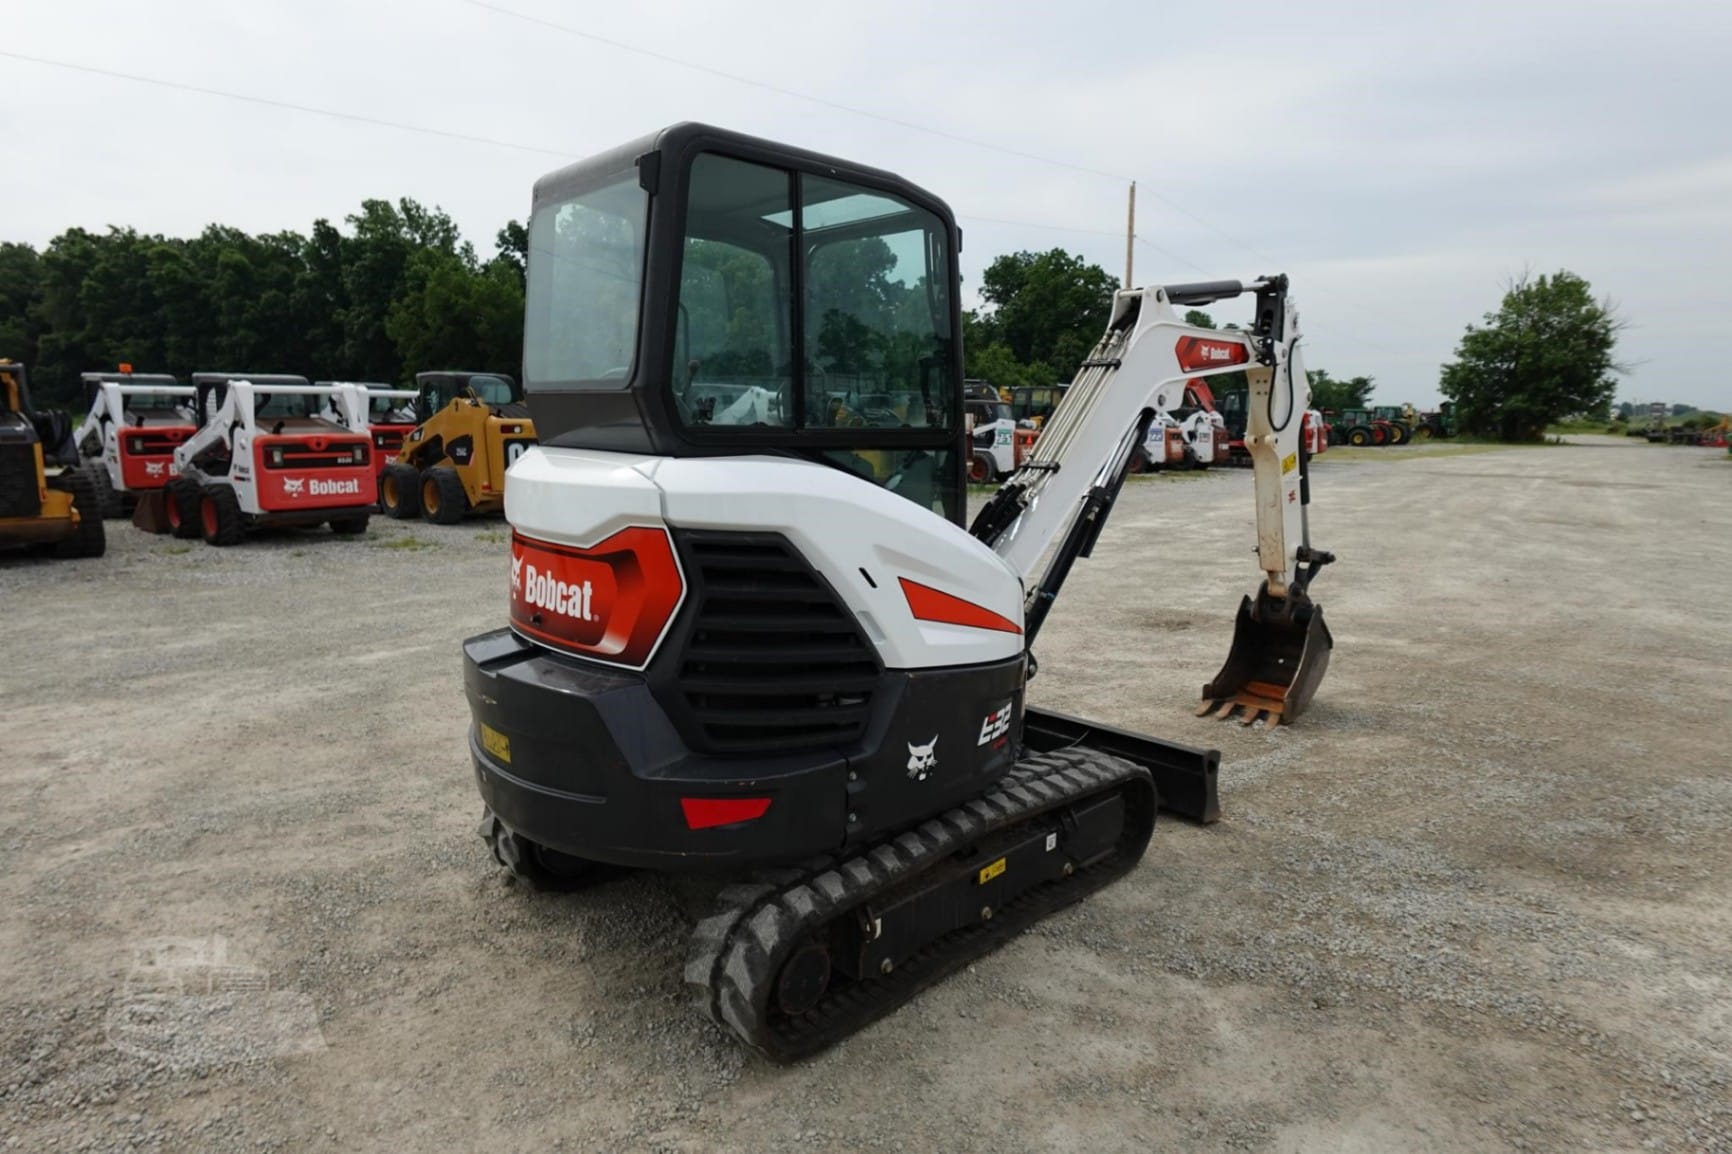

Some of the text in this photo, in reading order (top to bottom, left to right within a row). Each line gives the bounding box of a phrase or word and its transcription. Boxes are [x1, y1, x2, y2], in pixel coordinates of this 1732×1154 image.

[309, 479, 359, 495] Bobcat
[525, 564, 593, 622] Bobcat
[977, 702, 1012, 746] E32
